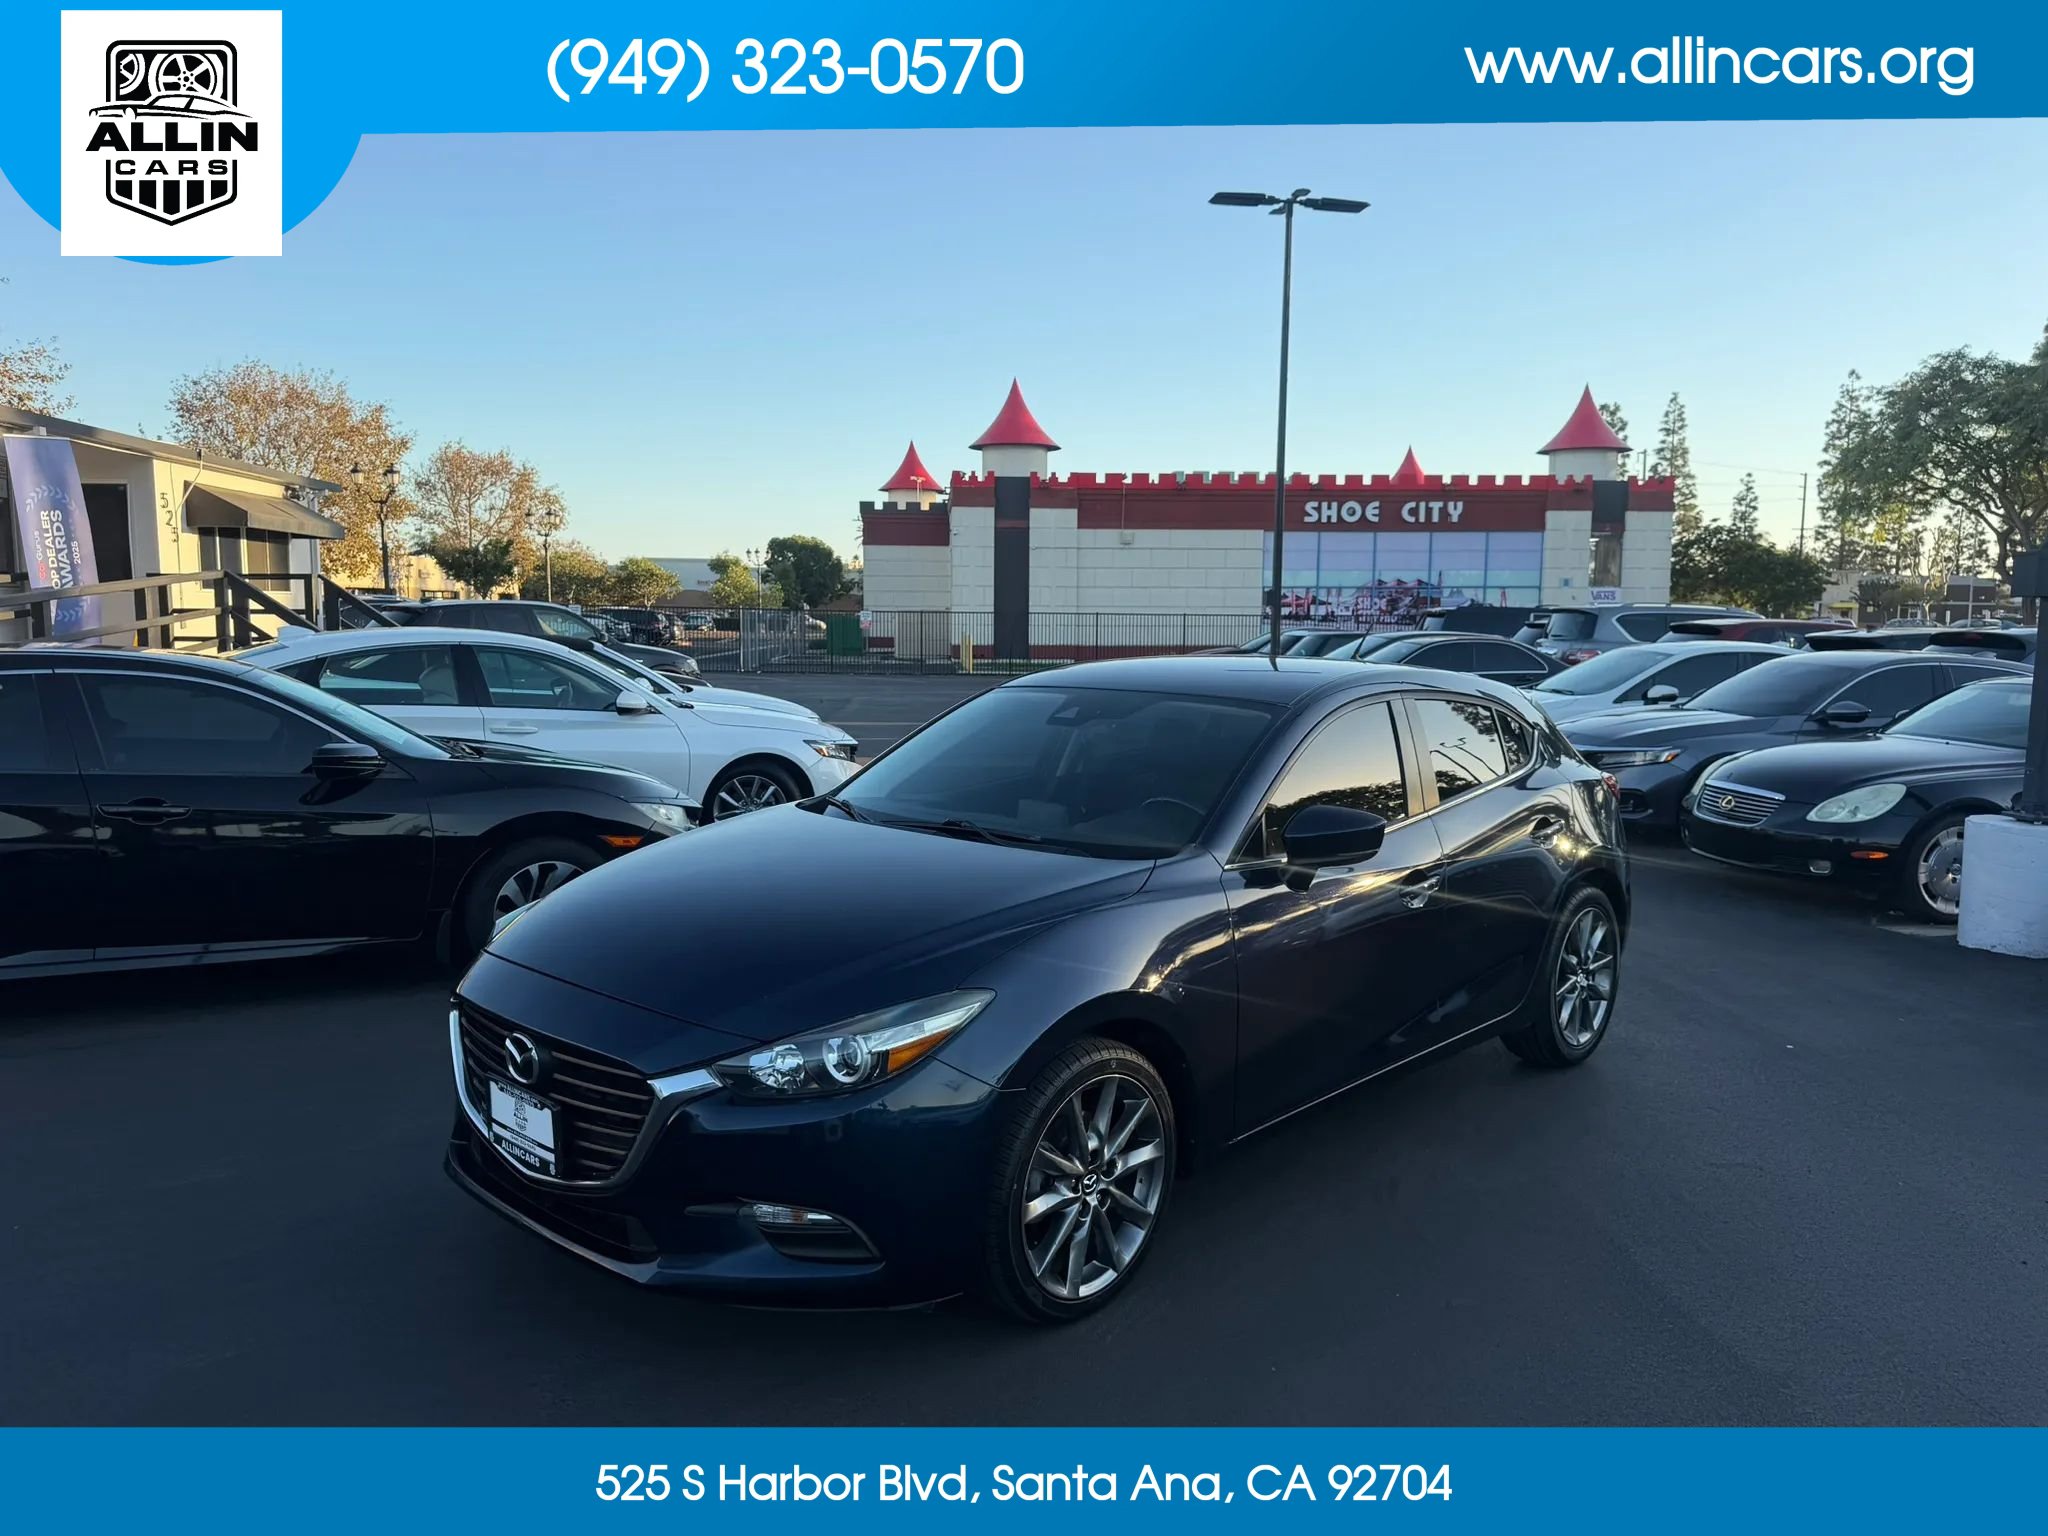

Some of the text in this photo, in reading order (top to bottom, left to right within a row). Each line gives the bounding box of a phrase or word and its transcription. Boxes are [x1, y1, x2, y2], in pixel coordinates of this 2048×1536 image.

[1303, 501, 1463, 523] SHOE CITY
[41, 510, 58, 567] DEALER
[1591, 590, 1616, 600] VANS
[502, 1139, 540, 1167] ALLINCARS
